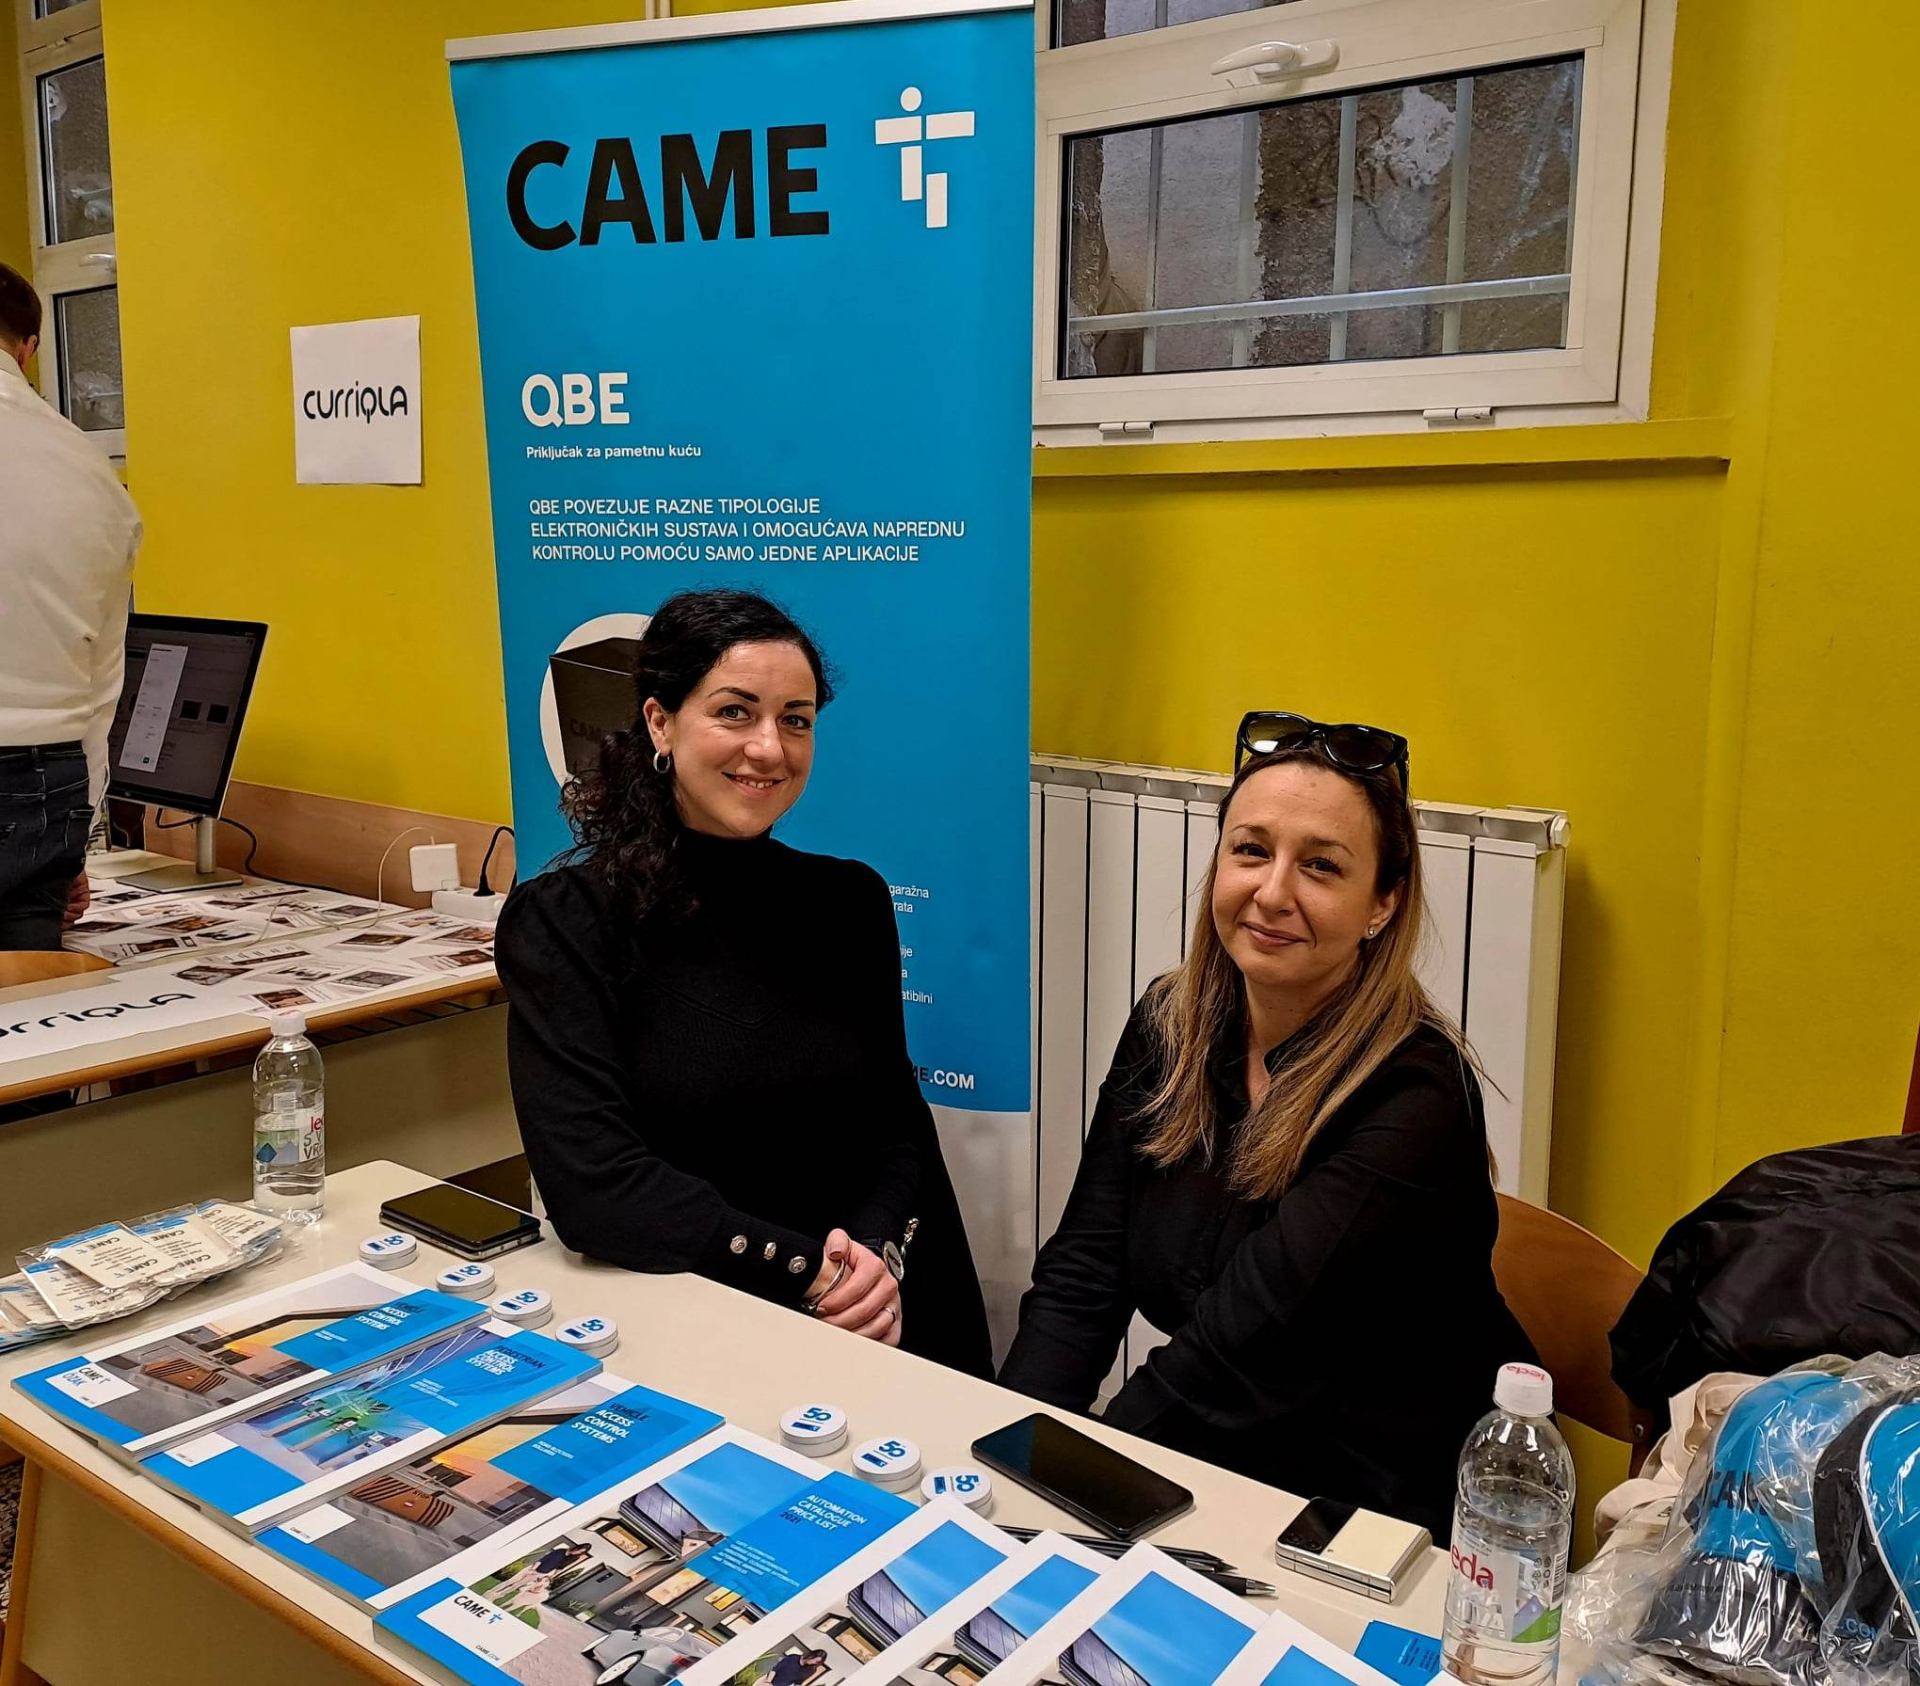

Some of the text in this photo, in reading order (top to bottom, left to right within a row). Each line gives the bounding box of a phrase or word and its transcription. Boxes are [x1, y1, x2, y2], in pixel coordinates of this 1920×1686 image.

[505, 123, 830, 251] CAME
[521, 372, 630, 428] QBE
[526, 443, 702, 461] Priključak za pametnu kuću
[529, 498, 820, 515] QBE POVEZUJE RAZNE TIPOLOGIJE
[530, 518, 965, 537] ELEKTRONIČKIH SUSTAVA I OMOGUĆAVA NAPREDNU
[532, 541, 919, 561] KONTROLU POMOĆU SAMO JEDNE APLIKACIJE
[888, 884, 930, 899] garažna
[151, 1229, 185, 1242] CAME
[125, 1258, 158, 1274] CAME
[596, 1409, 635, 1427] ACCESS
[803, 1407, 831, 1421] 50
[571, 1421, 617, 1444] SYSTEMS
[584, 1415, 630, 1439] CONTROL
[878, 1440, 906, 1458] 50
[955, 1474, 979, 1493] 50
[779, 1511, 801, 1525] 2021
[788, 1505, 839, 1532] PRICE LIST
[798, 1500, 852, 1528] CATALOGUE
[806, 1494, 868, 1525] AUTOMATION
[453, 1595, 491, 1619] CAME
